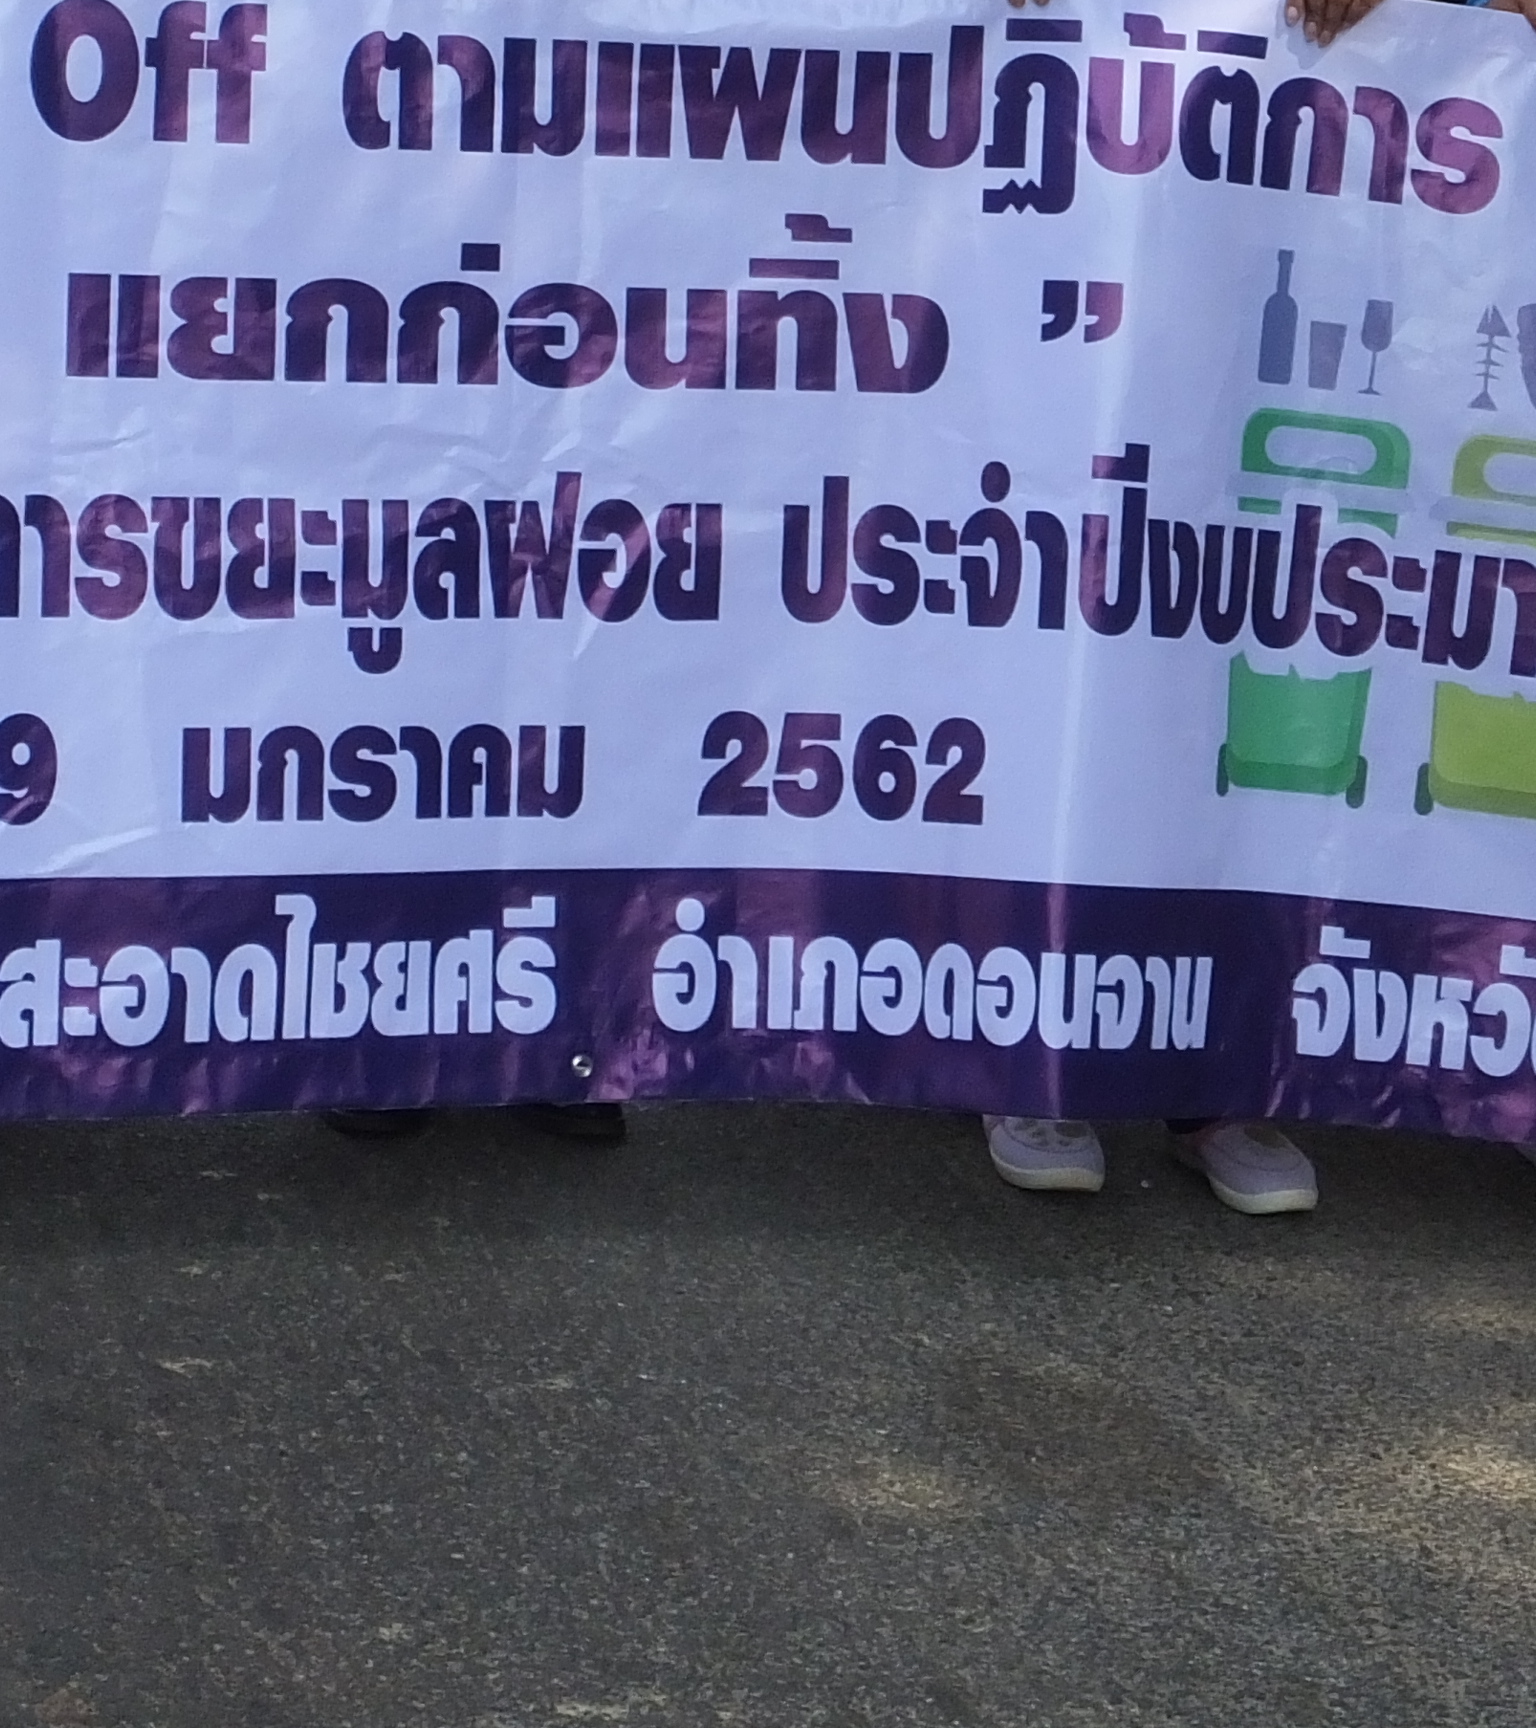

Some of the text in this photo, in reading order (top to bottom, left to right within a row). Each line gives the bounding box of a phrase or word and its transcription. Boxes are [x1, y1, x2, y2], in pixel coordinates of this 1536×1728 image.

[65, 213, 950, 394] แยกก่อนทิ้ง
[180, 724, 586, 825] มกราคม
[696, 709, 988, 826] 2562
[651, 896, 1213, 1052] อำเภอดอนจาน
